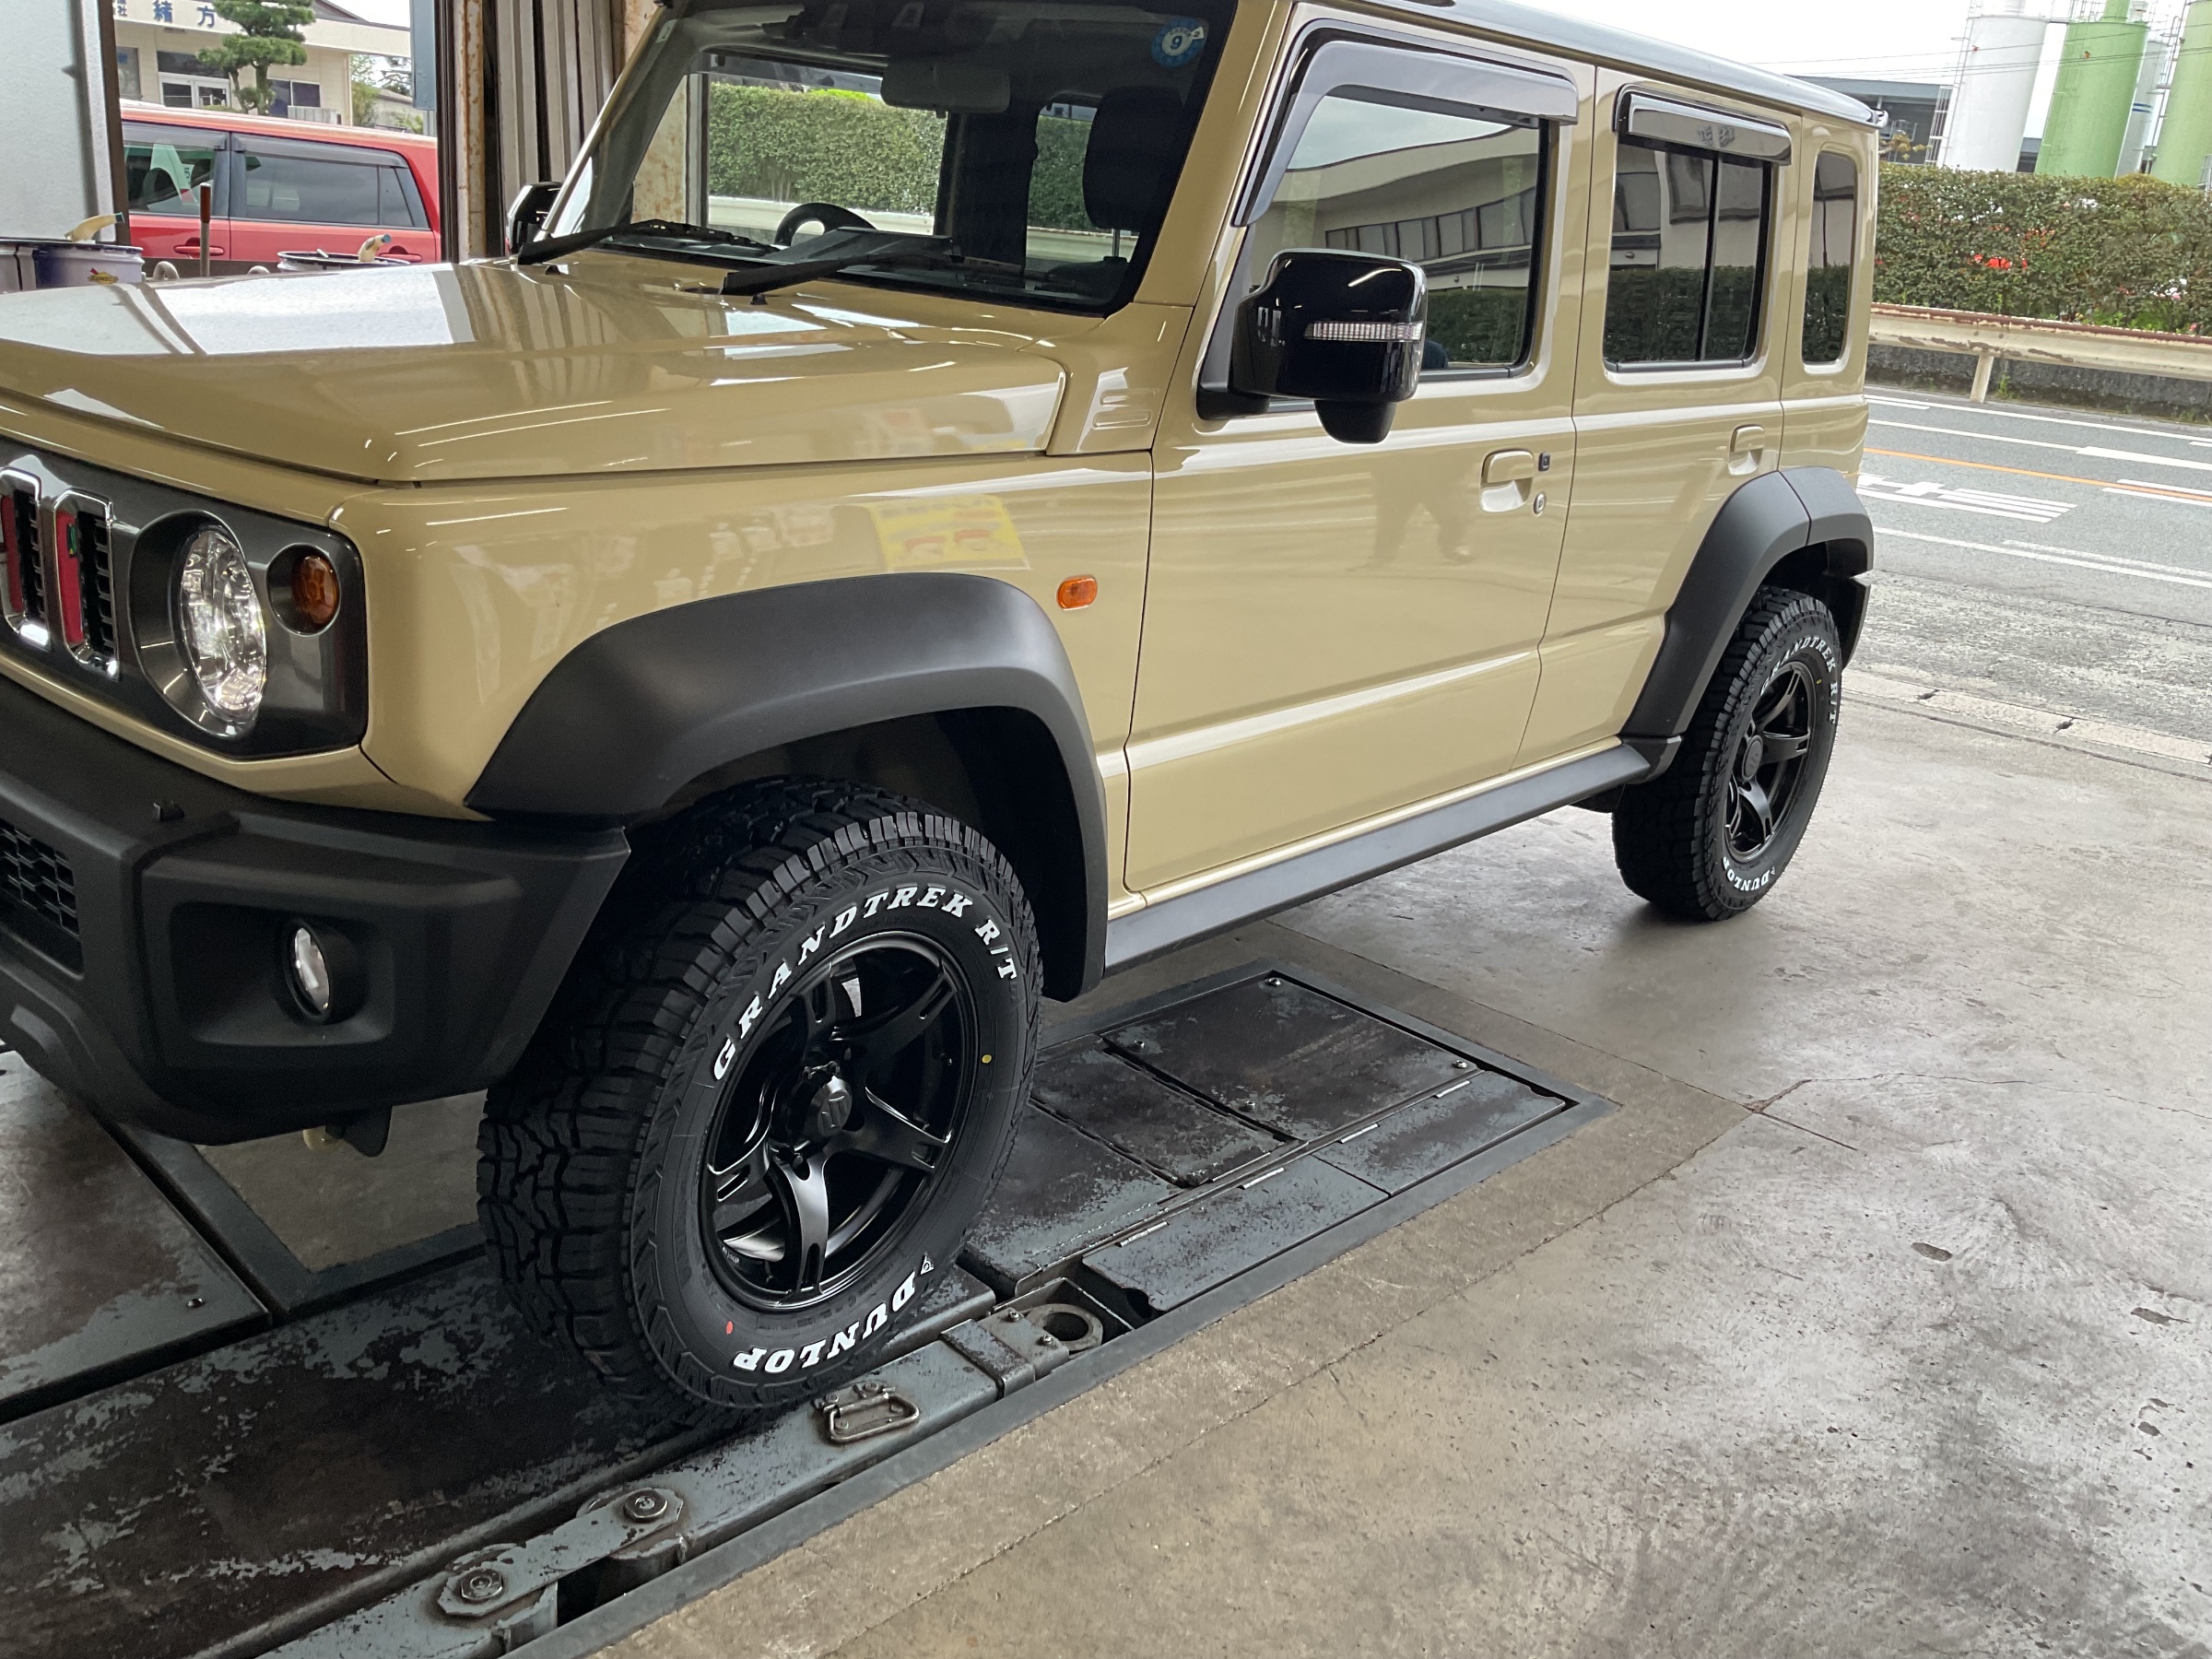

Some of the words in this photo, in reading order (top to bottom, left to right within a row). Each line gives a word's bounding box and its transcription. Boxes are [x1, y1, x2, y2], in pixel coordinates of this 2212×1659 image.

[1171, 36, 1182, 50] 9
[1760, 635, 1836, 696] GRANDTREK
[1829, 681, 1839, 724] R/T
[1723, 856, 1771, 891] DUNLOP
[713, 886, 973, 1080] GRANDTREK
[974, 919, 1018, 980] R/T
[733, 1270, 916, 1373] DUNLOP
